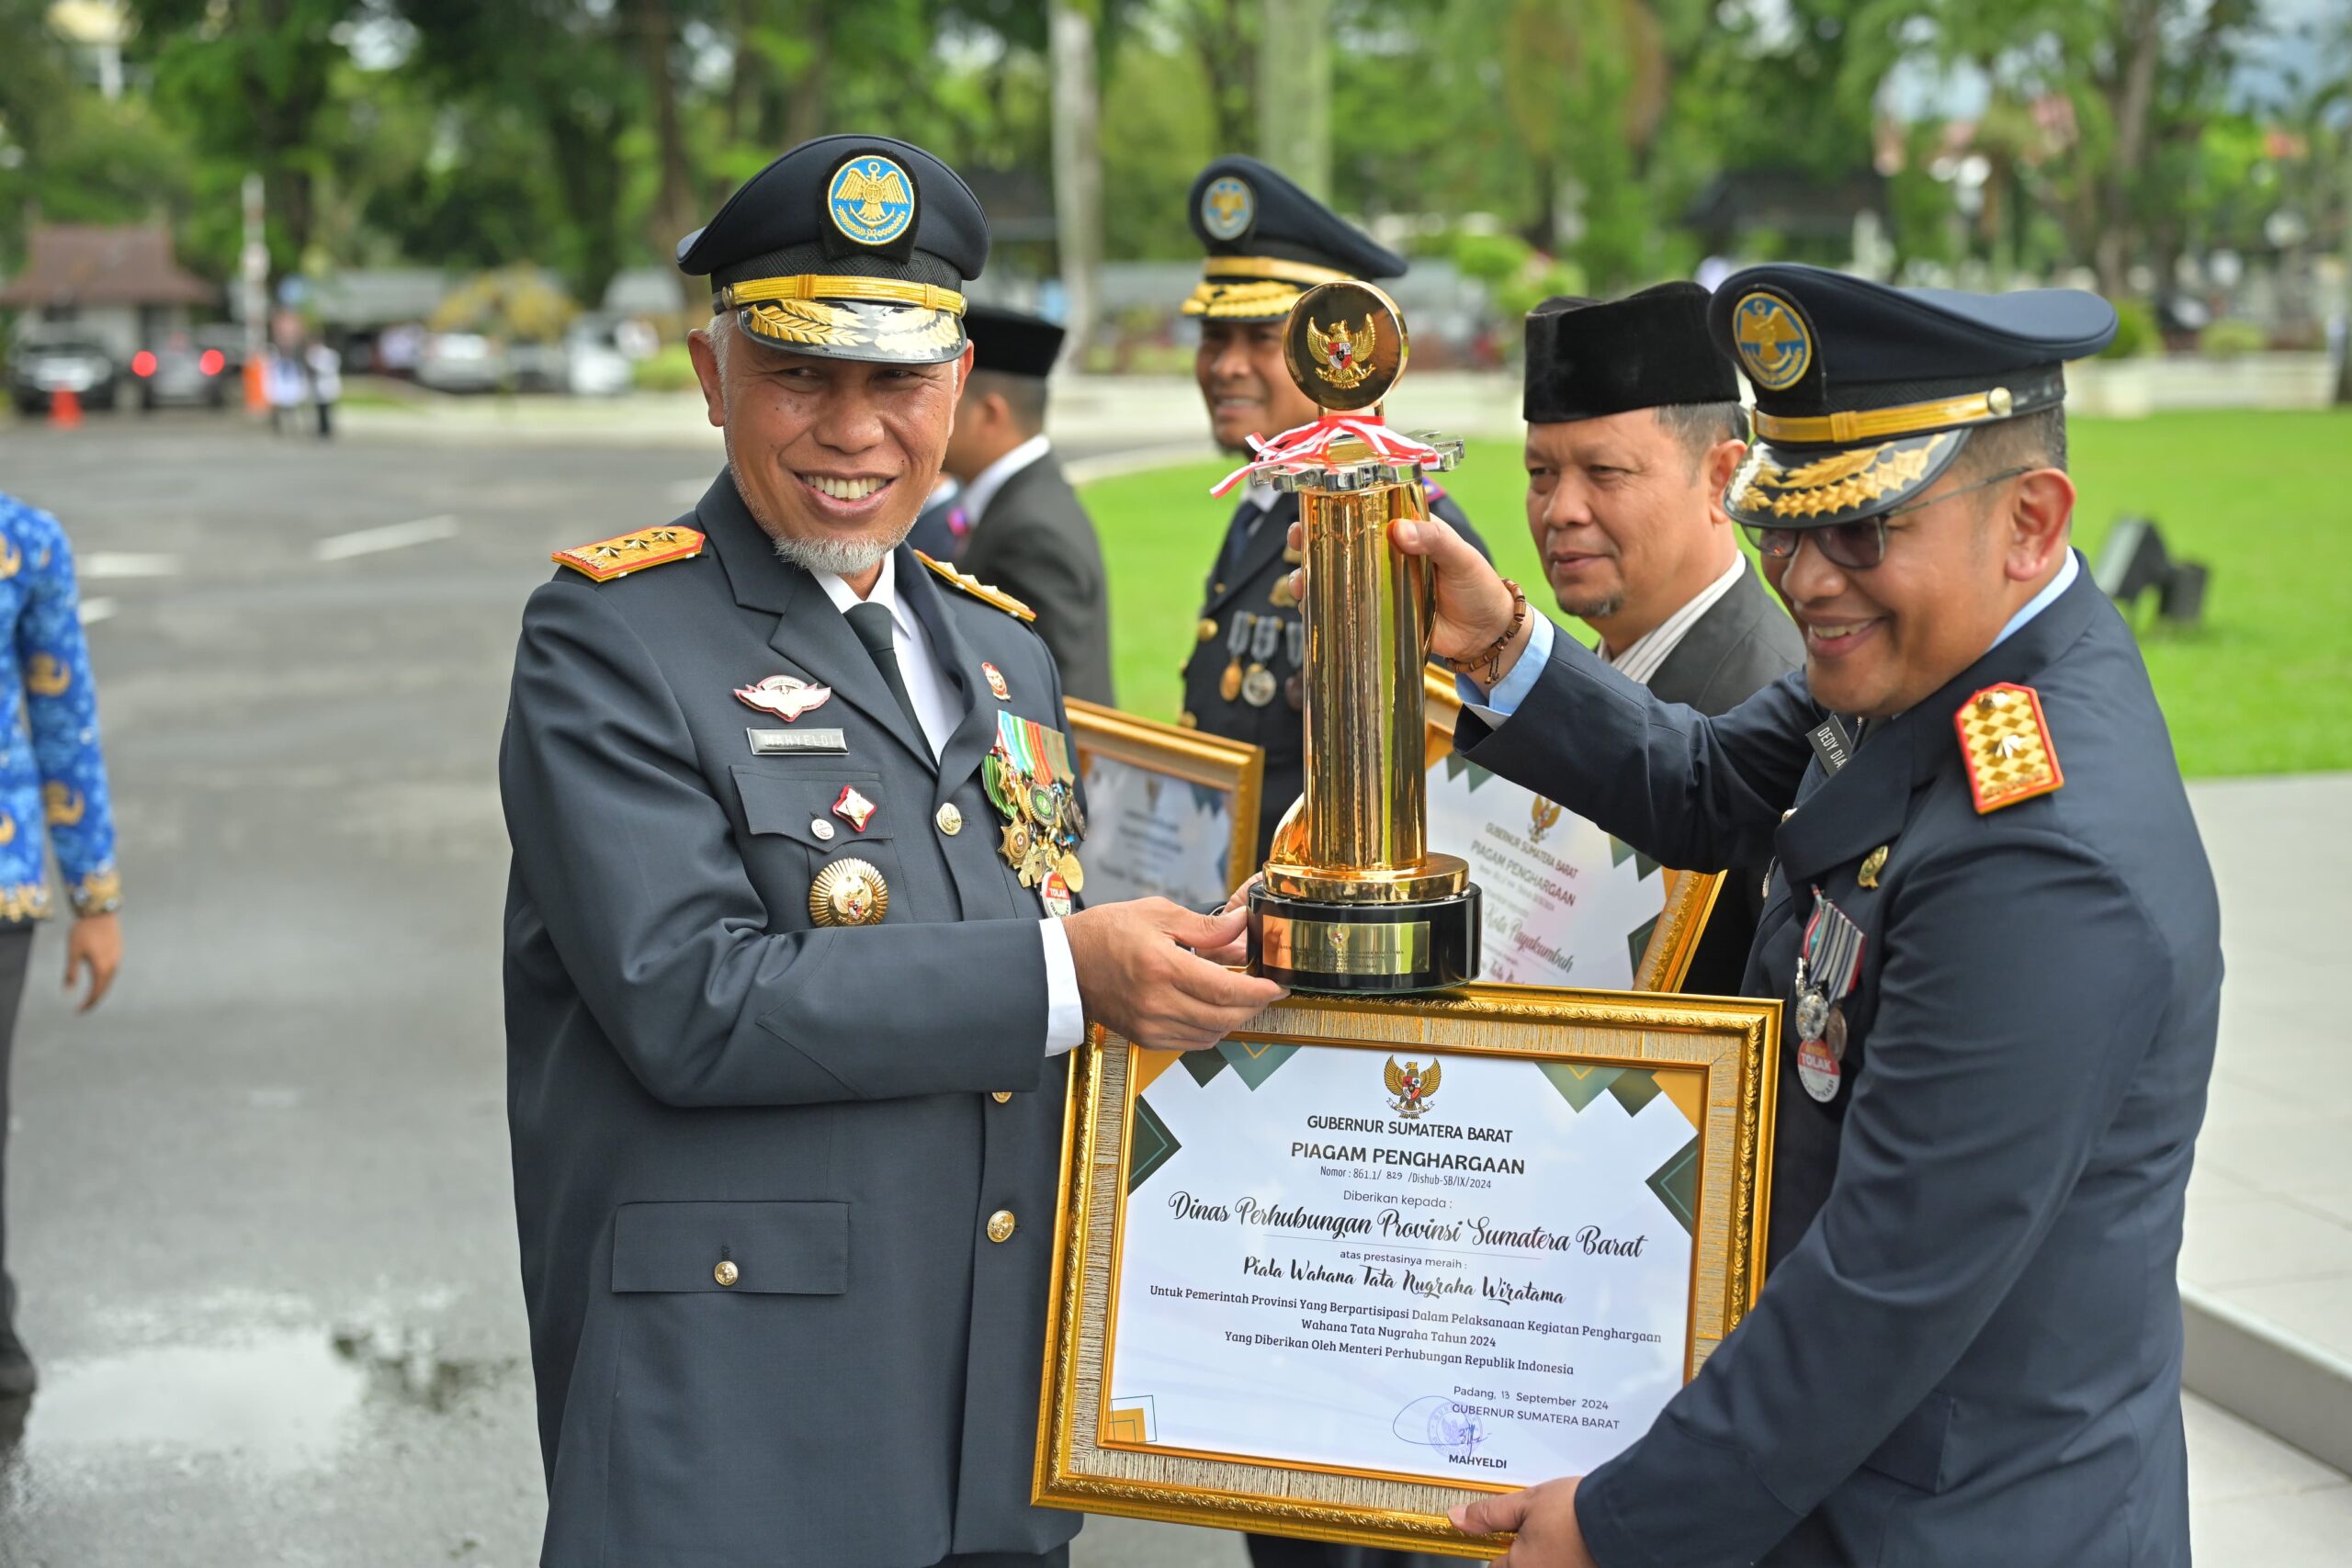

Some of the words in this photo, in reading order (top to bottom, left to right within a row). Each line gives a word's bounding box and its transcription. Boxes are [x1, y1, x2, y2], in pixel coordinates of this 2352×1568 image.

[764, 734, 834, 746] MAHYELDI
[1817, 727, 1839, 751] DEDY
[1830, 749, 1848, 771] DIA
[1485, 822, 1521, 849] GUBERNUR
[1521, 840, 1555, 868] SUMATERA
[1555, 858, 1578, 880] BARAT
[1471, 840, 1507, 865] PIAGAM
[1506, 859, 1576, 908] PENGHARGAAN
[1509, 919, 1574, 974] Payakumbuh
[1801, 1053, 1832, 1073] TOLAK
[1306, 1115, 1384, 1134] GUBERNUR
[1387, 1122, 1463, 1139] SUMATERA
[1467, 1126, 1513, 1144] BARAT
[1291, 1142, 1366, 1162] PIAGAM
[1373, 1148, 1525, 1175] PENGHARGAAN
[1320, 1166, 1346, 1178] Nomor
[1386, 1171, 1403, 1180] 829
[1343, 1190, 1398, 1204] Diberikan
[1401, 1195, 1446, 1209] kepada
[1168, 1190, 1231, 1223] Dinas
[1235, 1196, 1373, 1240] Perhubungan
[1377, 1208, 1463, 1242] Provinsi
[1467, 1216, 1571, 1251] Sumatera
[1576, 1224, 1649, 1258] Barat
[1340, 1250, 1361, 1260] atas
[1363, 1252, 1422, 1267] prestasinya
[1426, 1258, 1462, 1269] meraih
[1243, 1256, 1284, 1278] Piala
[1290, 1258, 1356, 1284] Wahana
[1359, 1264, 1397, 1288] Tata
[1402, 1269, 1476, 1300] Nugraha
[1482, 1276, 1566, 1305] Wiratama
[1149, 1285, 1183, 1298] Untuk
[1185, 1289, 1249, 1303] Pemerintah
[1251, 1295, 1297, 1309] Provinsi
[1300, 1299, 1328, 1314] Yang
[1329, 1302, 1409, 1319] Berpartisipasi
[1412, 1310, 1449, 1323] Dalam
[1452, 1314, 1525, 1330] Pelaksanaan
[1527, 1320, 1579, 1336] Kegiatan
[1582, 1325, 1662, 1344] Penghargaan
[1301, 1319, 1348, 1333] Wahana
[1350, 1324, 1375, 1336] Tata
[1378, 1326, 1428, 1341] Nugraha
[1430, 1331, 1467, 1345] Tahun
[1470, 1335, 1496, 1348] 2024
[1225, 1331, 1252, 1346] Yang
[1255, 1334, 1308, 1348] Diberikan
[1311, 1339, 1336, 1352] Oleh
[1339, 1342, 1383, 1357] Menteri
[1385, 1348, 1462, 1364] Perhubungan
[1464, 1355, 1515, 1369] Republik
[1517, 1359, 1574, 1375] Indonesia
[1453, 1386, 1496, 1400] Padang,
[1501, 1391, 1510, 1400] 13
[1516, 1392, 1577, 1406] September
[1581, 1399, 1609, 1410] 2024
[1452, 1404, 1514, 1419] GUBERNUR
[1517, 1410, 1578, 1426] SUMATERA
[1582, 1417, 1620, 1430] BARAT
[1449, 1454, 1507, 1469] MAHYELDI
